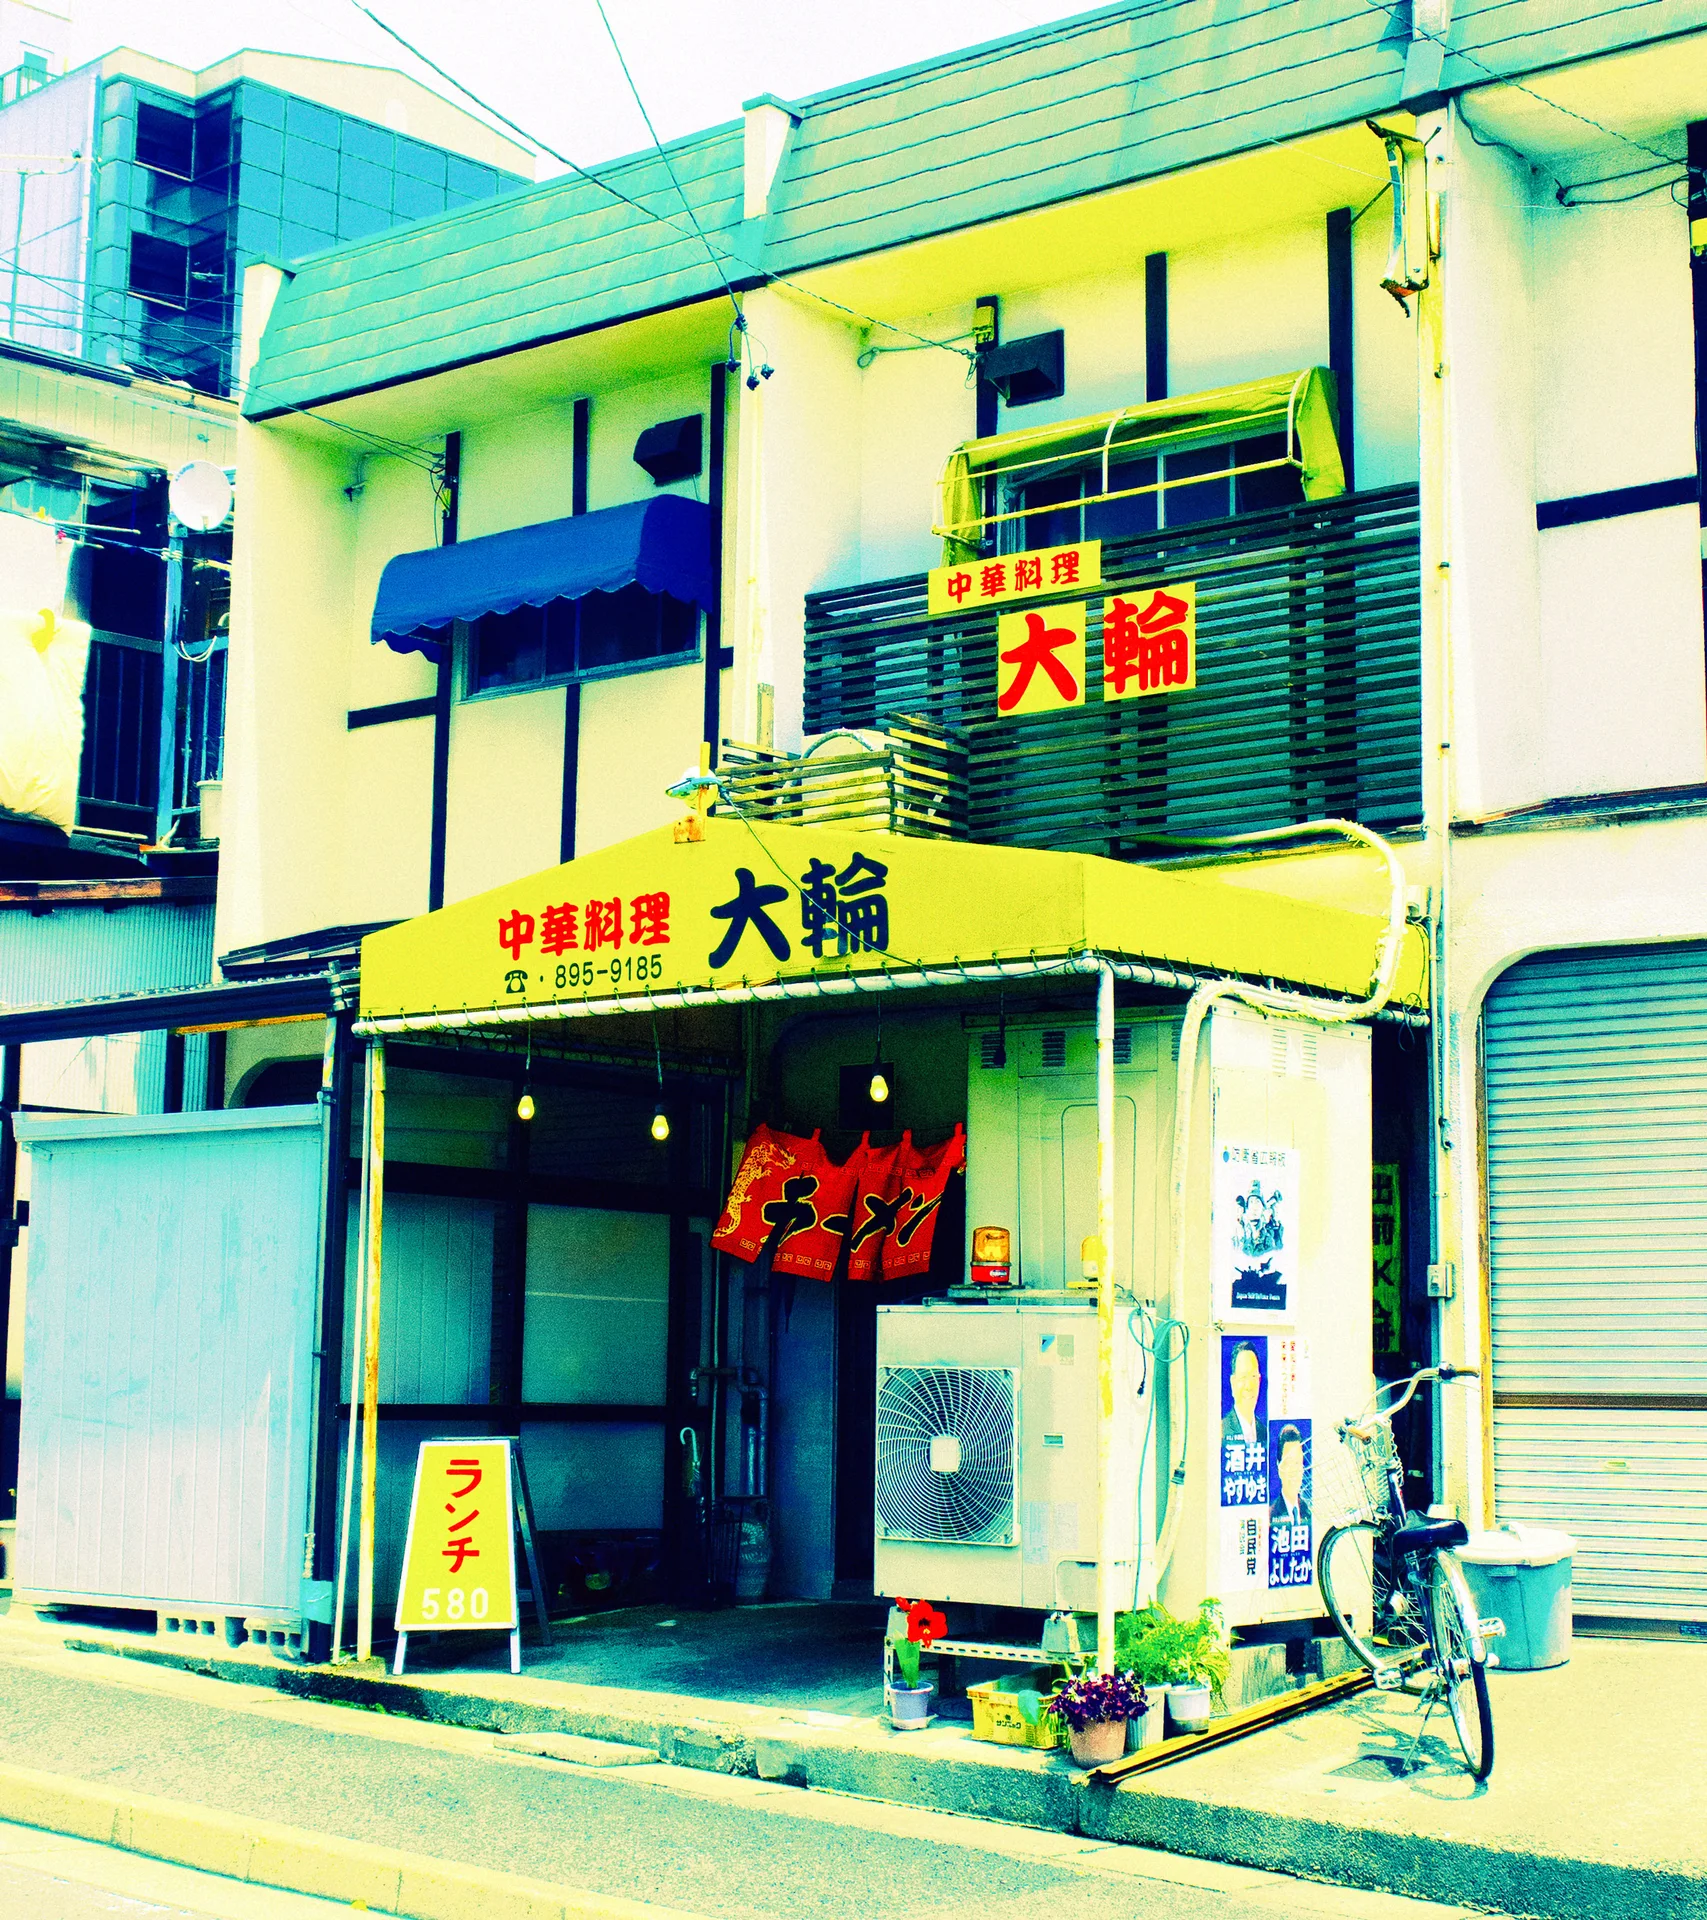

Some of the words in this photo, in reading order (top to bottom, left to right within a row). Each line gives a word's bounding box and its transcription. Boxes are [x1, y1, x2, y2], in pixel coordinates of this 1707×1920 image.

[947, 550, 1080, 604] 中華料理
[998, 590, 1188, 711] 大輪
[498, 890, 671, 961] 中華料理
[708, 851, 889, 970] 大輪
[1224, 1442, 1266, 1473] 酒井
[442, 1459, 482, 1573] ランチ
[1223, 1475, 1267, 1504] やすゆき
[1246, 1518, 1257, 1576] 自民党
[1271, 1525, 1309, 1554] 池田
[1269, 1556, 1313, 1586] よしたか
[422, 1587, 489, 1620] 580
